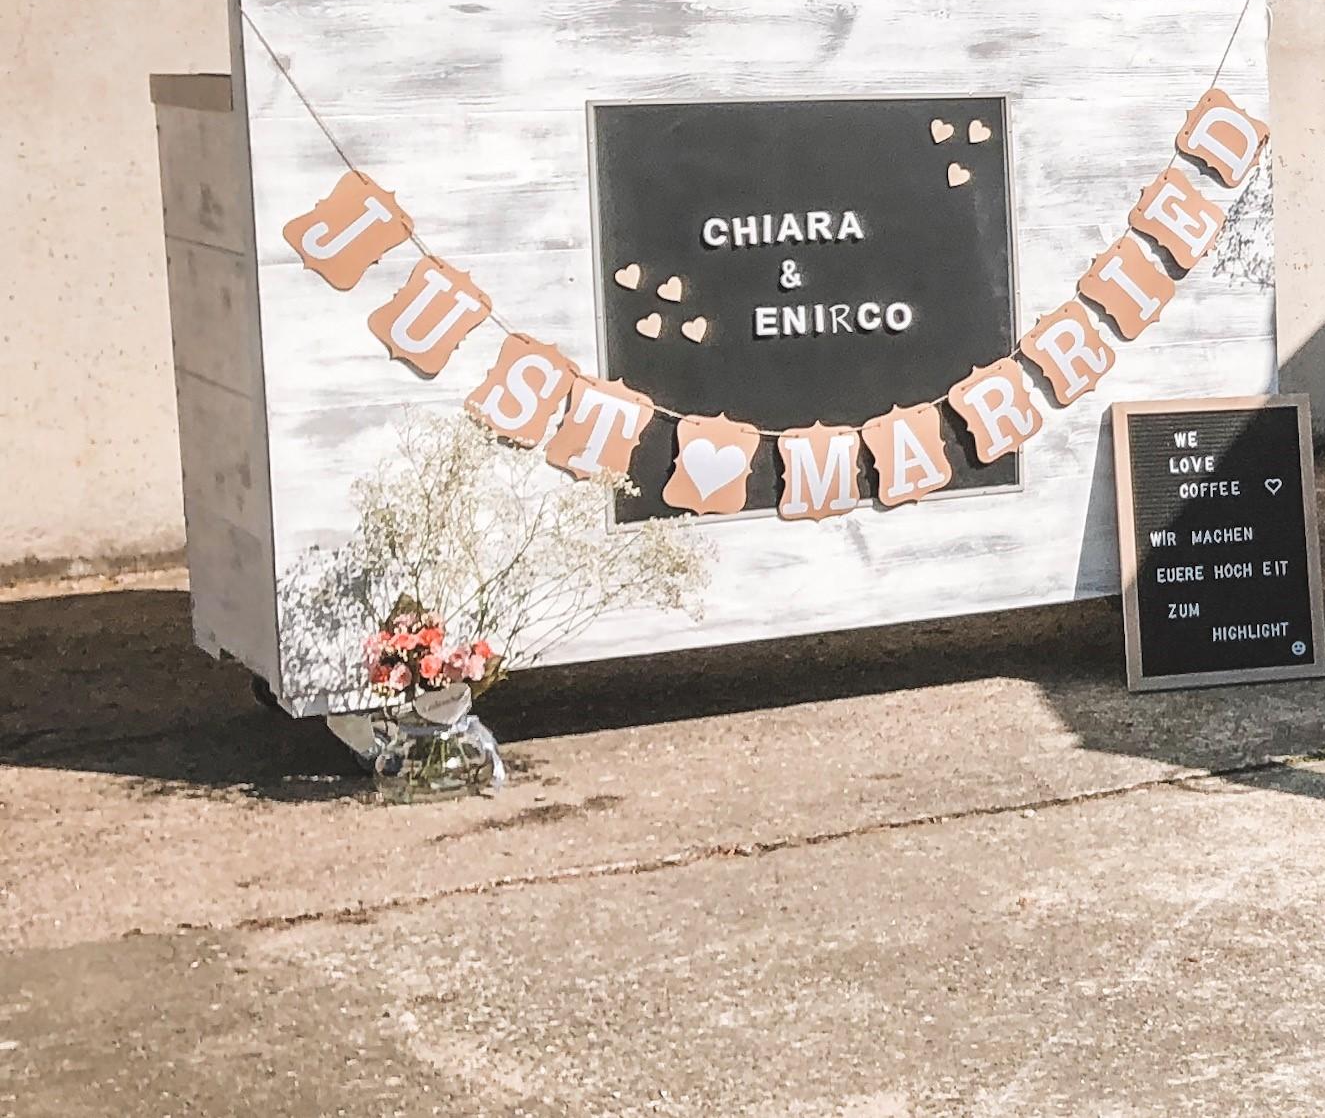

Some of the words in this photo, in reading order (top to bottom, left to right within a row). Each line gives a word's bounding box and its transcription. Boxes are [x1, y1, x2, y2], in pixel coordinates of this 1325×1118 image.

[702, 210, 865, 247] CHIARA
[780, 258, 802, 289] &
[301, 195, 641, 476] JUST
[782, 105, 1259, 514] MARRIED
[754, 302, 913, 336] ENIRCO
[1174, 431, 1198, 448] WE
[1169, 456, 1215, 474] LOVE
[1179, 480, 1241, 499] COFFEE
[1150, 529, 1177, 548] WIR
[1191, 526, 1253, 546] MACHEN
[1156, 565, 1205, 583] EUERE
[1168, 602, 1200, 619] ZUM
[1212, 621, 1289, 642] HIGHLIGHT
